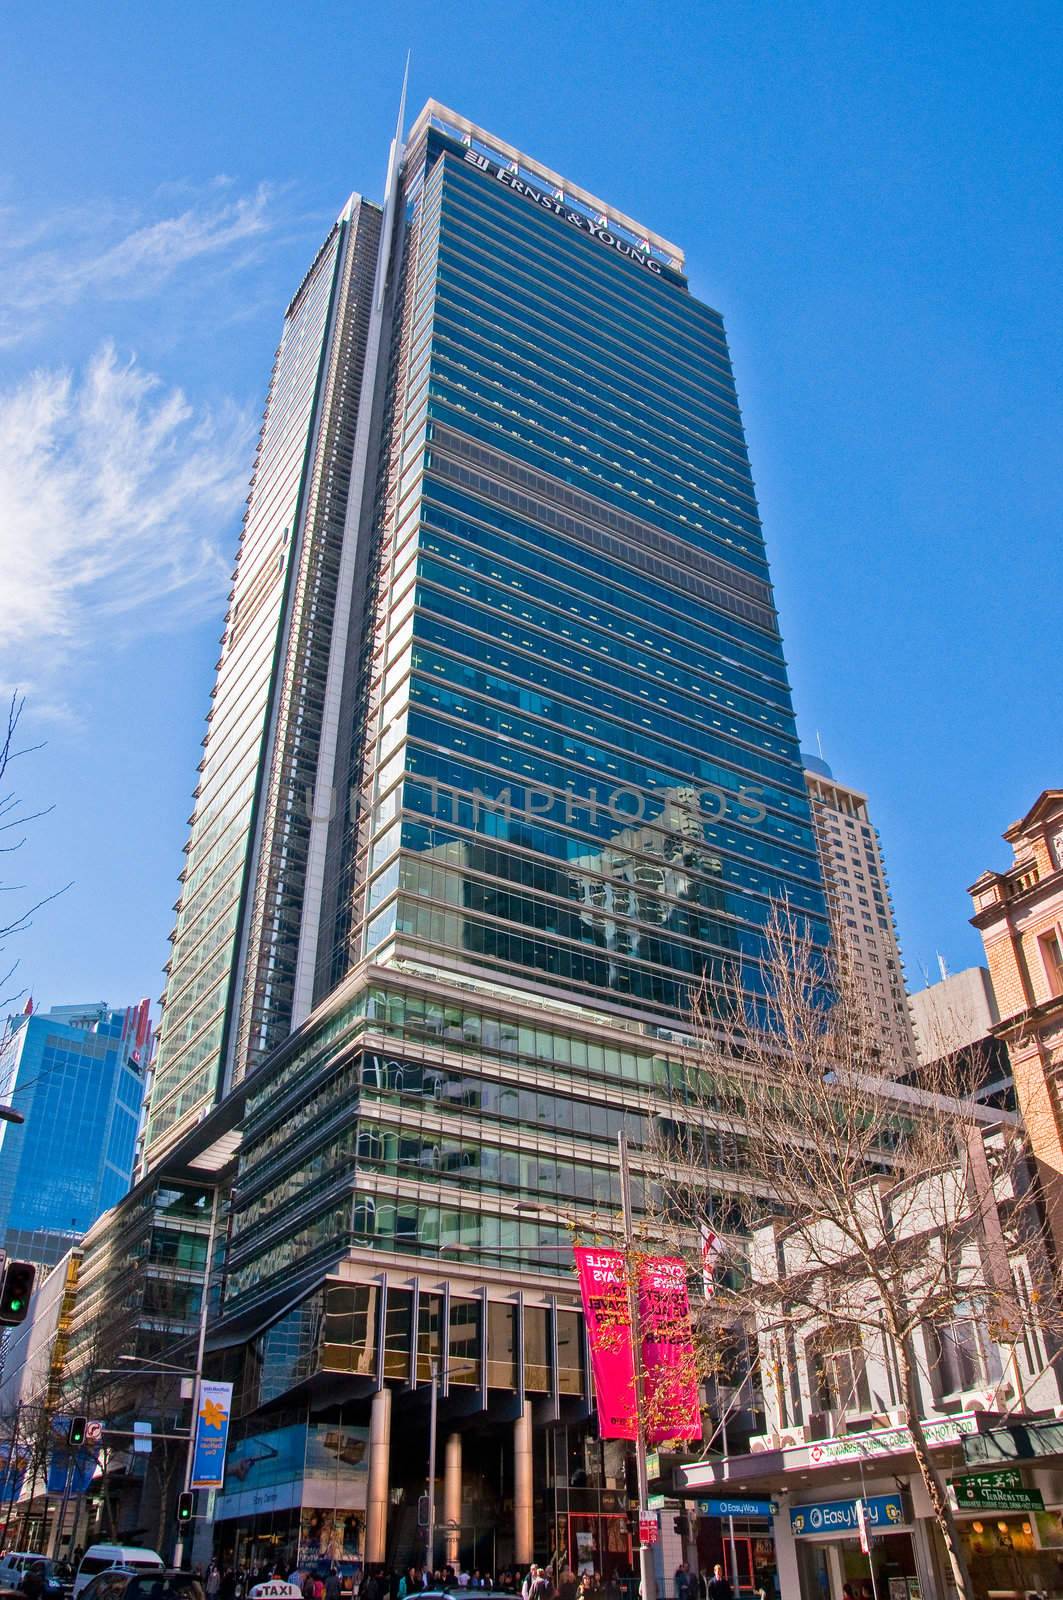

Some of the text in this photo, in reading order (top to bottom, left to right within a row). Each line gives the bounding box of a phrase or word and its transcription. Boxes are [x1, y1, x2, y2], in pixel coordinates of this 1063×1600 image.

[496, 168, 661, 274] ERNST & YOUNG
[951, 1420, 973, 1435] FOOD
[727, 1503, 759, 1514] EasyWay
[262, 1585, 292, 1596] TAXI
